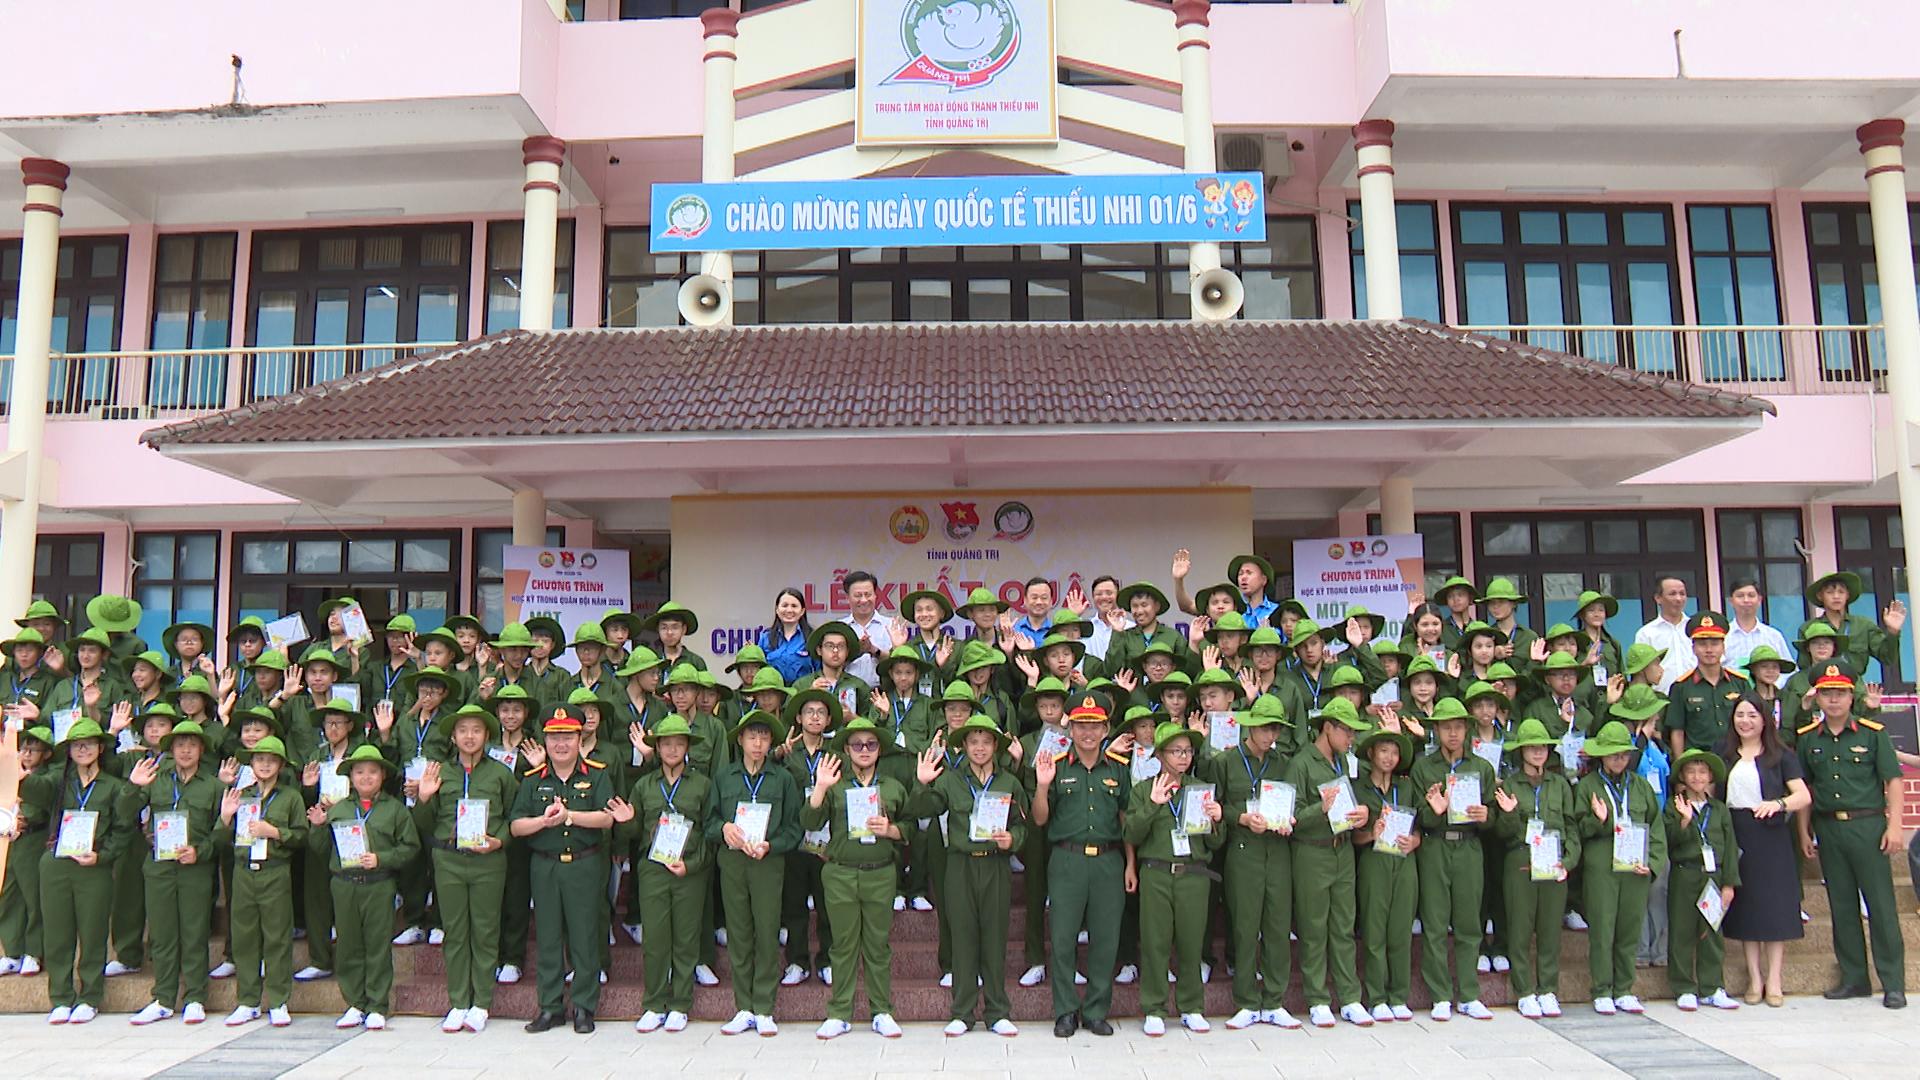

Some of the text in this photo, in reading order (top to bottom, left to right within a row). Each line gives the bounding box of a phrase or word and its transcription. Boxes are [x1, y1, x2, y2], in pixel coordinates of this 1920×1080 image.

[875, 99, 1039, 114] TRUNG TÂM HOẠT ĐỘNG THANH THIẾU NHI
[925, 117, 989, 130] TỈNH QUẢNG TRỊ
[725, 183, 1198, 232] CHÀO MỪNG NGÀY QUỐC TẾ THIẾU NHI 01/6
[927, 548, 999, 562] TỈNH QUẢNG TRỊ
[804, 568, 851, 612] LỄ
[1326, 587, 1348, 595] TRONG
[536, 596, 558, 604] TRONG
